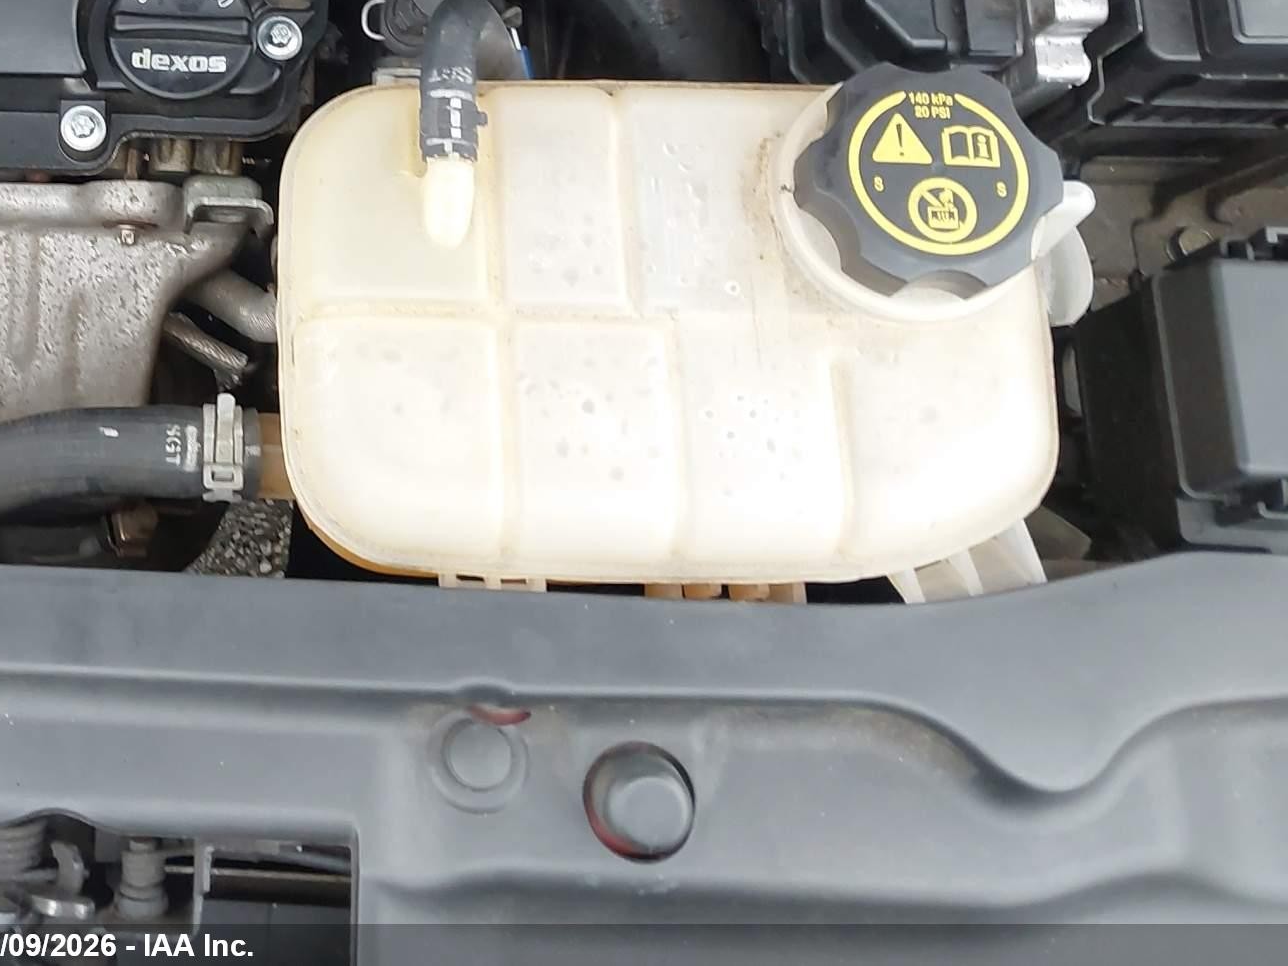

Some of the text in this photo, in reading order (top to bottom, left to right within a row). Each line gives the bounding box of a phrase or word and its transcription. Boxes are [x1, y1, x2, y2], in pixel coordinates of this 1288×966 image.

[131, 47, 227, 73] dexos
[908, 92, 954, 106] 140 kPa
[914, 106, 952, 120] 20 PSI
